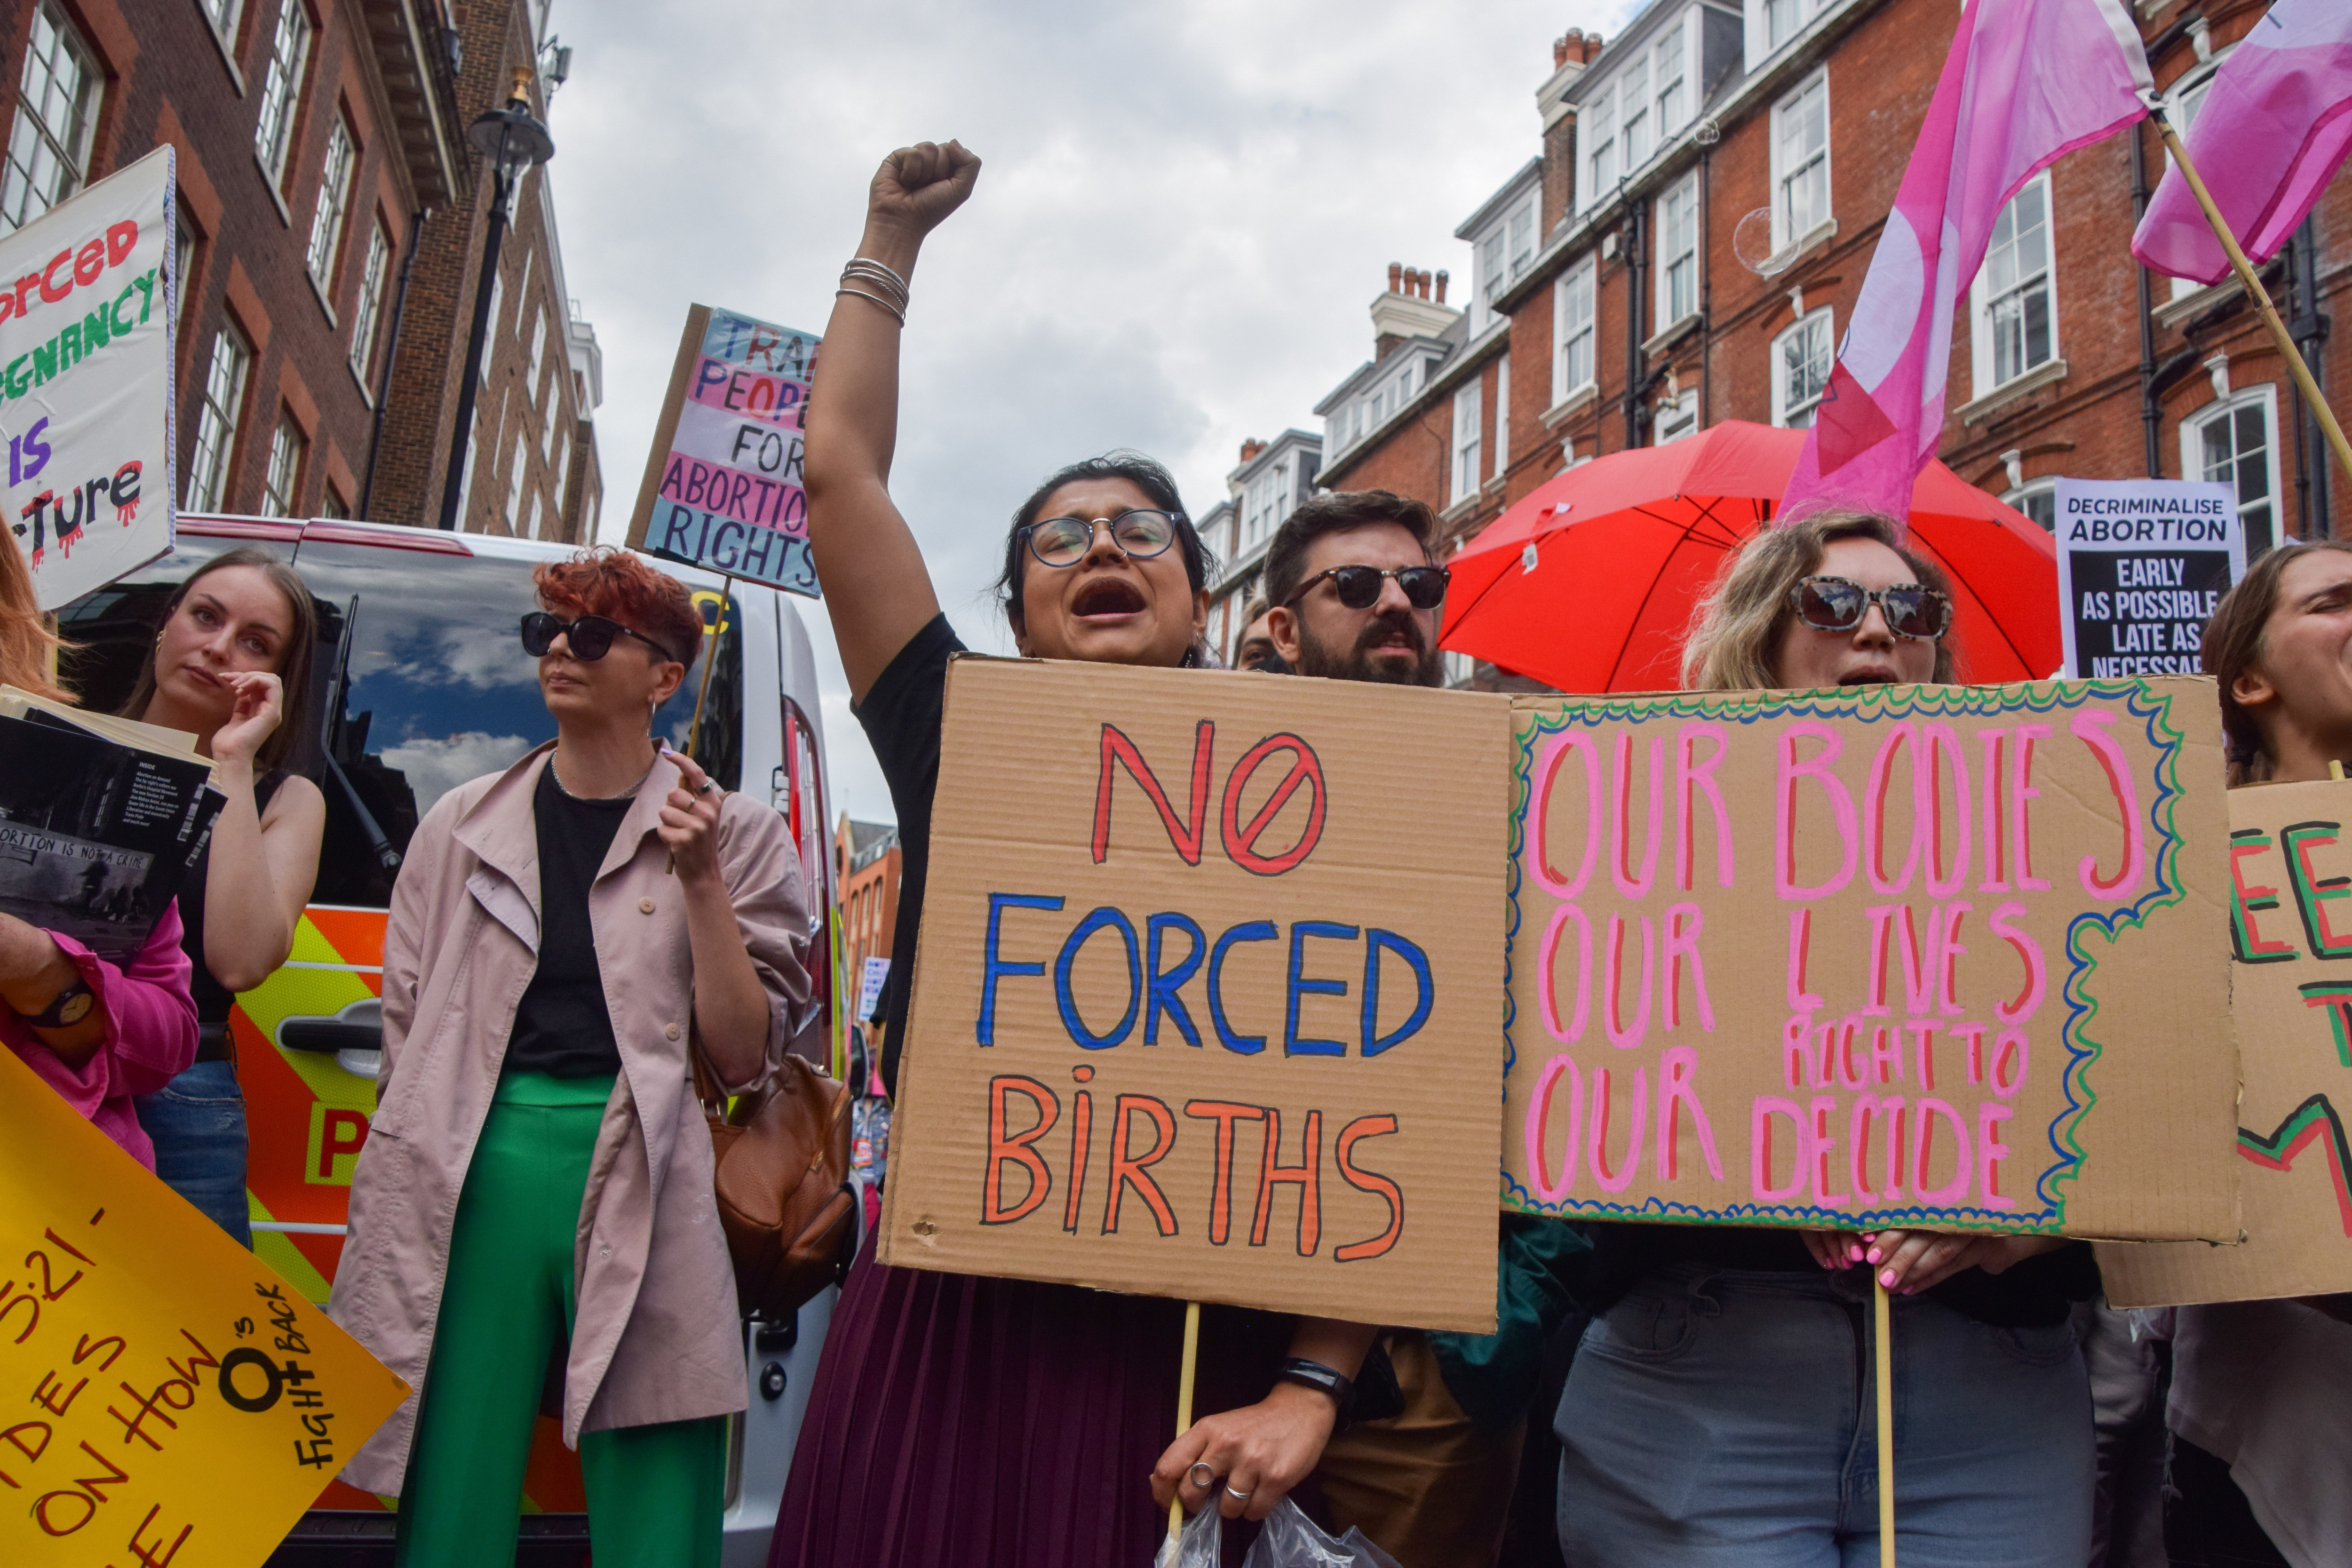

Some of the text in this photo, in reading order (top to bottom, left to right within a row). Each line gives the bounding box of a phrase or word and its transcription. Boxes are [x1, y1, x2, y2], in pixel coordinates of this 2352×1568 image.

[0, 268, 157, 406] GNANCY
[9, 416, 51, 488] IS
[731, 424, 804, 481] FOR
[660, 457, 810, 537] ABORTIO
[2068, 498, 2224, 514] DECRIMINALISE
[2069, 519, 2226, 541] ABORTION
[664, 505, 816, 587] RIGHTS
[2117, 558, 2185, 587] EARLY
[2082, 590, 2218, 620] AS POSSIBLE
[2112, 623, 2201, 653] LATE AS
[1527, 708, 2145, 901] OUR BODIES
[62, 844, 74, 856] IS
[81, 846, 104, 861] NOT
[106, 852, 112, 863] A
[117, 854, 144, 869] CRIME
[976, 891, 1434, 1058] FORCED
[1538, 900, 2047, 1049] OUR LIVES
[1783, 1013, 2029, 1099] RIGHT TO
[1525, 1046, 1724, 1203] OUR
[1751, 1090, 2016, 1210] DECIDE
[254, 1282, 311, 1354] BACK
[30, 1440, 129, 1536] ON
[107, 1329, 222, 1451] HOW
